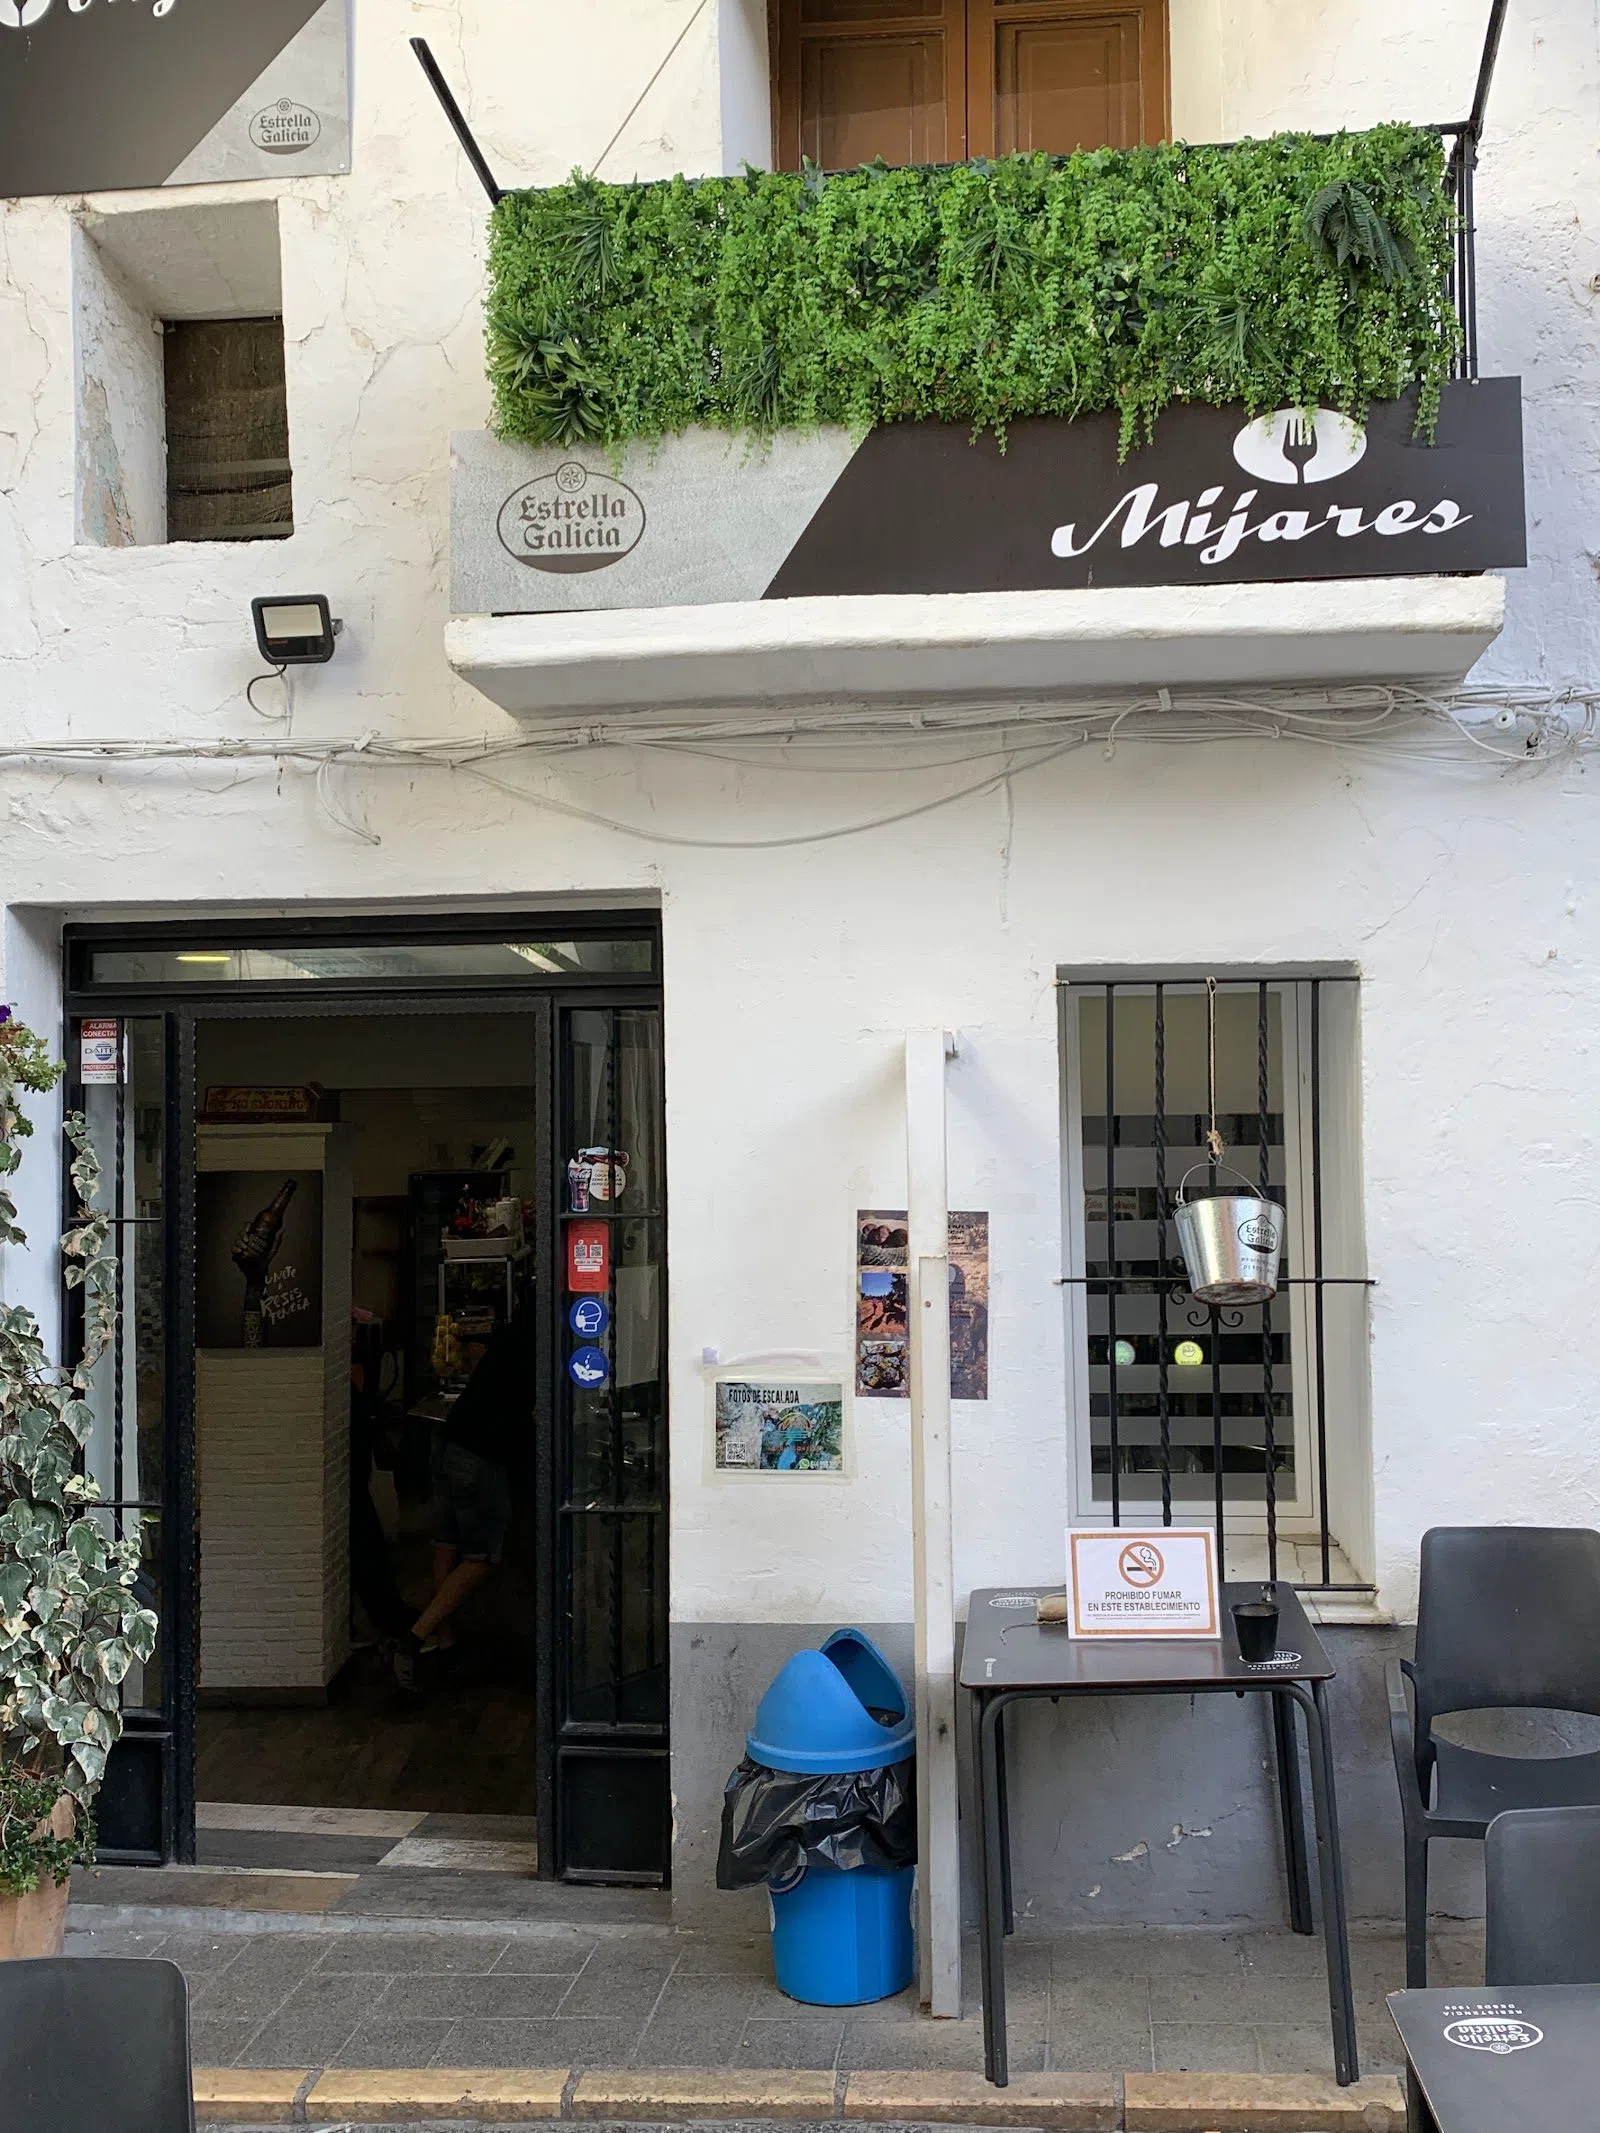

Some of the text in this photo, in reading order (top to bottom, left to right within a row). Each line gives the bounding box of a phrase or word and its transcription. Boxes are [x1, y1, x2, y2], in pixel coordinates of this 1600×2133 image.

[260, 114, 312, 129] Estrella
[261, 128, 309, 143] Galicia
[518, 493, 626, 522] Estrella
[1050, 482, 1473, 564] Mijares
[523, 520, 620, 550] Galicia
[1246, 1224, 1275, 1239] Estrella
[1247, 1234, 1274, 1247] Galicia
[729, 1389, 800, 1404] FOTOS DE ESCALADA
[1105, 1590, 1182, 1600] PROHIBIDO FUMAR
[1088, 1602, 1200, 1612] EN ESTE ESTABLECIMIENTO
[1458, 2024, 1523, 2034] Galicia
[1458, 2033, 1530, 2043] Estrella
